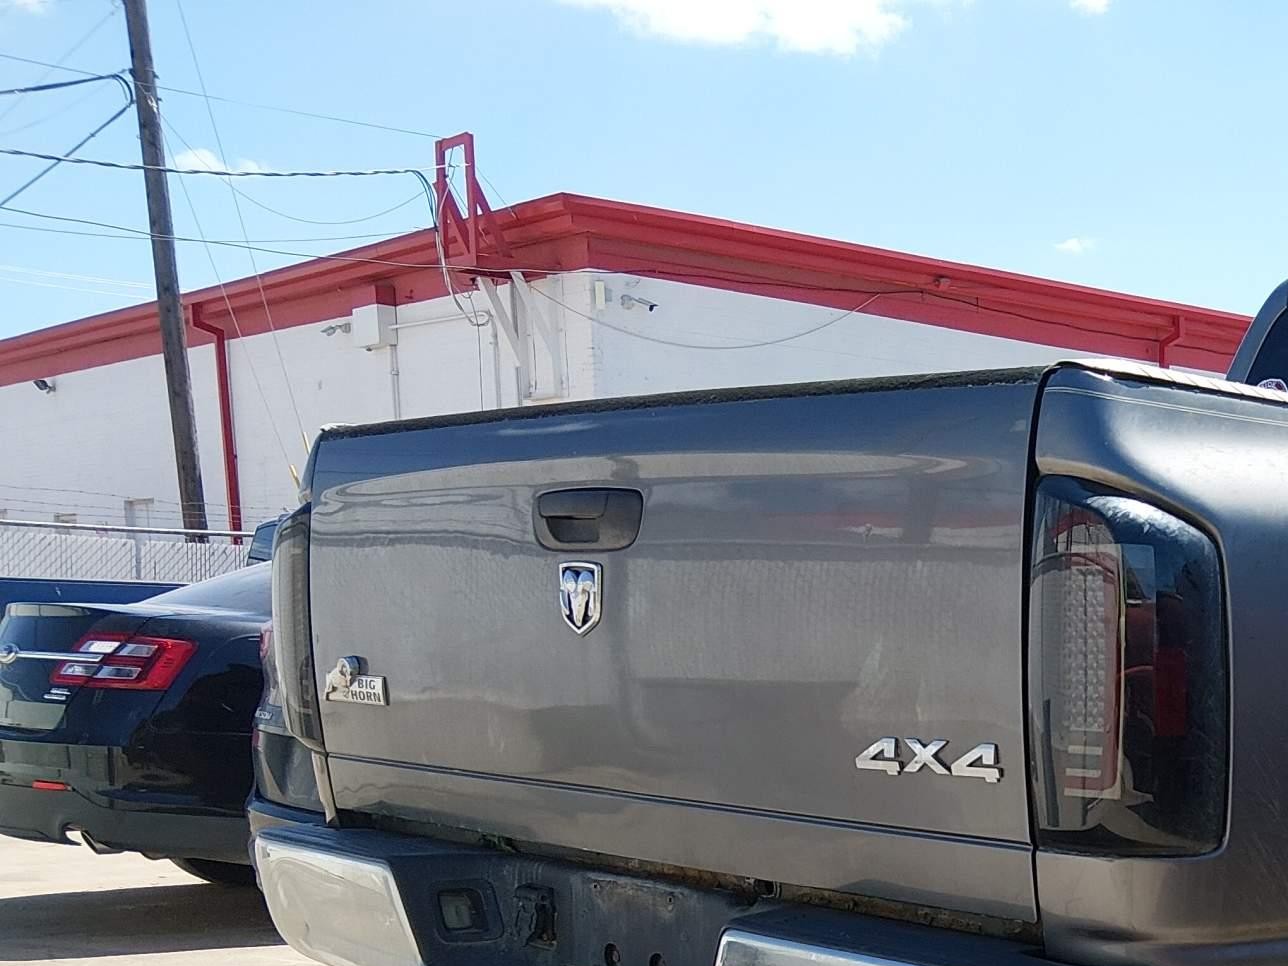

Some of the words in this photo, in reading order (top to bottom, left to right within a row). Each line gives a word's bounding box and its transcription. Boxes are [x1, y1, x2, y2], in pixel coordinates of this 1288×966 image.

[357, 678, 376, 690] BIG
[350, 690, 382, 703] HORN
[855, 736, 1003, 783] 4X4
